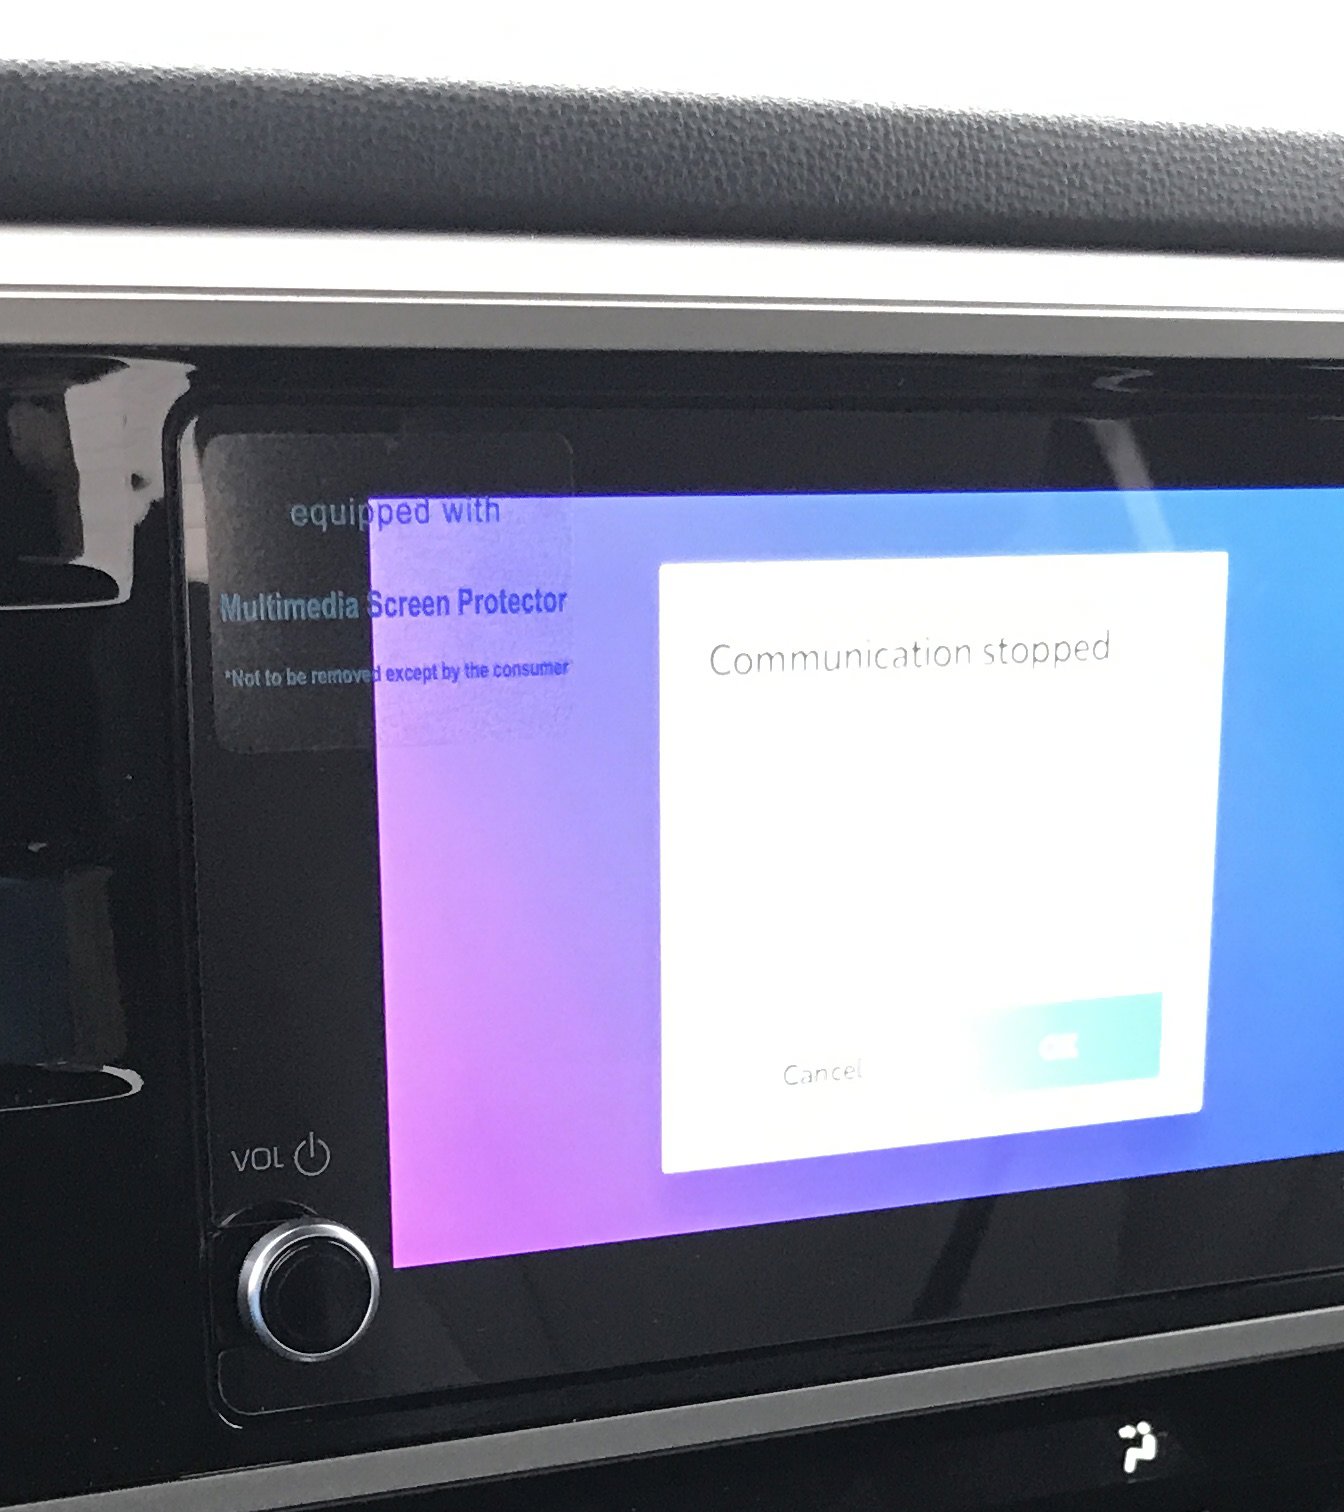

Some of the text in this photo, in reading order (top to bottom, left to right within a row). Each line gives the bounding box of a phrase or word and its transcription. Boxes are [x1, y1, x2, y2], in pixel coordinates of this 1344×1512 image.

[290, 496, 501, 532] equipped with
[219, 588, 568, 622] Multimedia Screen Protector
[710, 630, 1111, 676] Communication stopped
[265, 669, 283, 687] to
[286, 667, 307, 686] be
[312, 664, 382, 685] removed
[386, 662, 439, 684] except
[442, 662, 460, 683] by
[464, 662, 490, 679] the
[493, 660, 570, 678] consumer
[783, 1058, 863, 1086] Cancel
[230, 1146, 285, 1172] VOL
